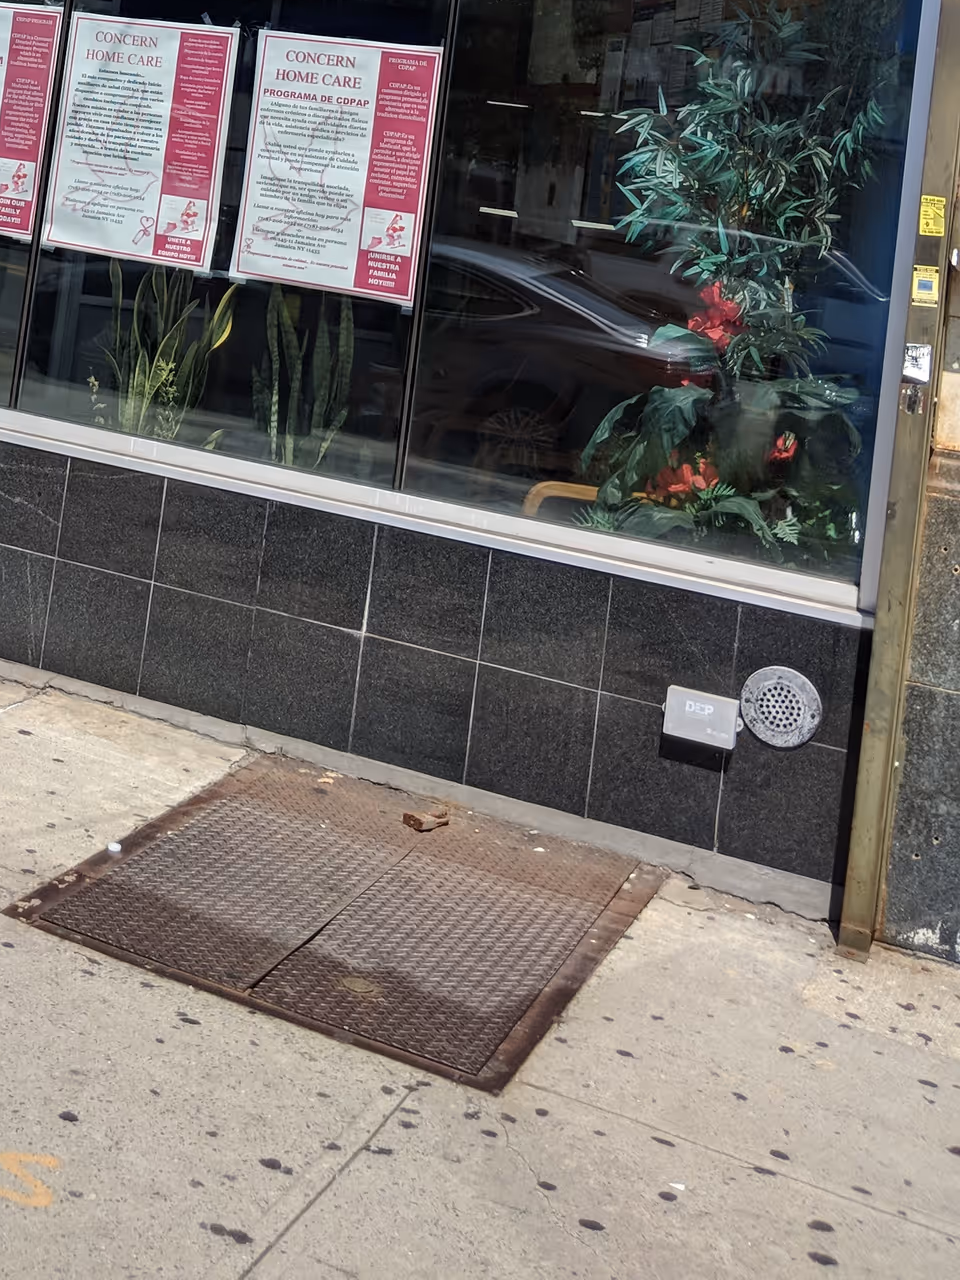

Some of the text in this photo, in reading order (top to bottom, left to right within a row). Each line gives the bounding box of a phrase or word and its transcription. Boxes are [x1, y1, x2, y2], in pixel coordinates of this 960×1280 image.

[94, 30, 158, 48] CONCERN
[85, 48, 163, 67] HOME CARE
[285, 49, 356, 68] CONCERN
[388, 57, 418, 65] PROGRAMA
[274, 68, 362, 89] HOME CARE
[263, 88, 317, 101] PROGRAMA
[335, 96, 369, 107] CDPAP
[11, 199, 25, 207] OUR
[157, 249, 178, 257] EQUIPO
[164, 243, 190, 252] NUESTRO
[367, 260, 399, 270] NUESTRA
[368, 269, 396, 278] FAMILIA
[685, 700, 714, 715] DEP
